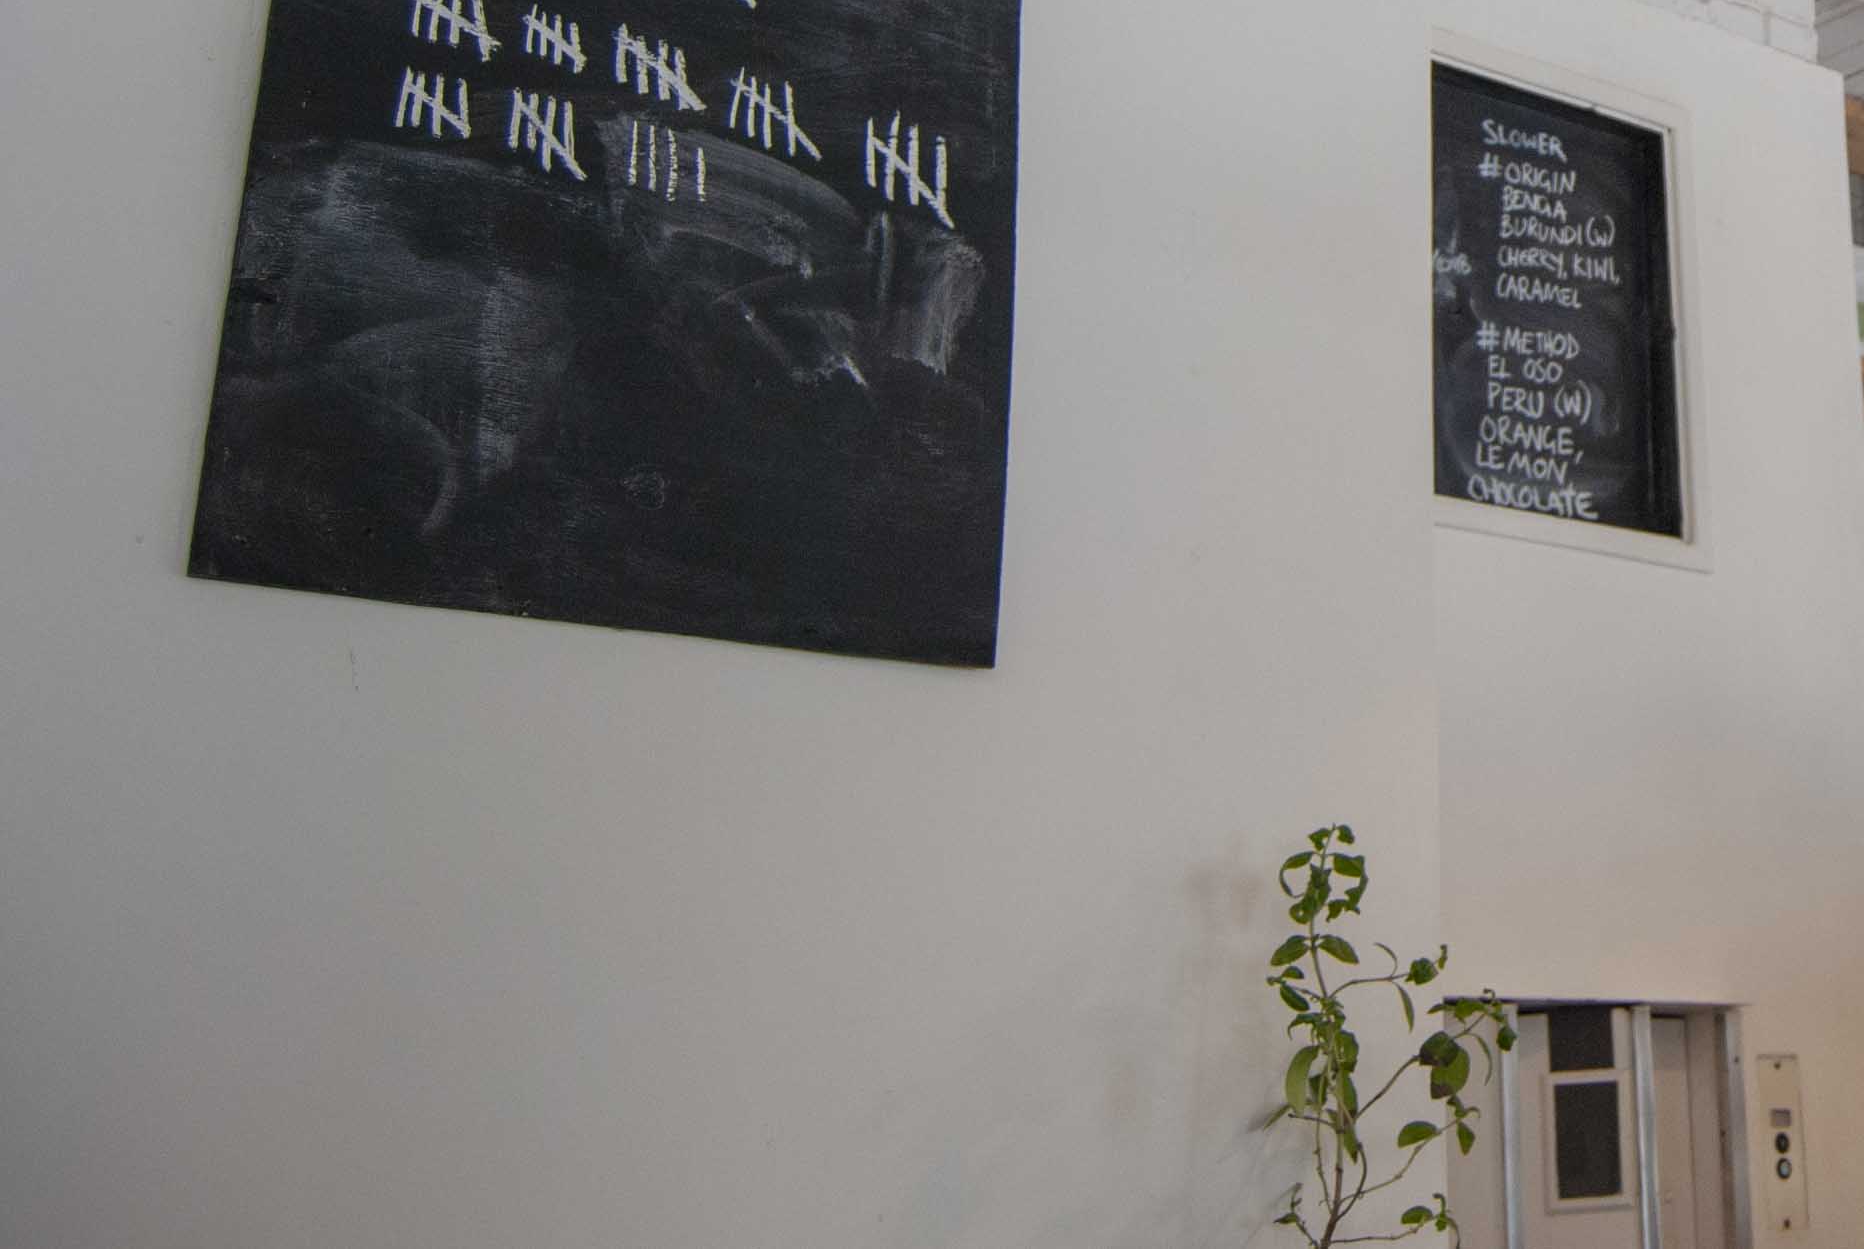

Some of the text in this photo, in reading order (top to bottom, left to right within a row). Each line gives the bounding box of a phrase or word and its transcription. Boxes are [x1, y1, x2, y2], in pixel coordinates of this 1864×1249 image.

[1482, 118, 1568, 164] SLOWER
[1496, 272, 1583, 309] CARAMEL
[1487, 353, 1564, 384] EL OSO
[1487, 381, 1545, 420] PERU
[1467, 473, 1600, 520] CHOCOLATE
